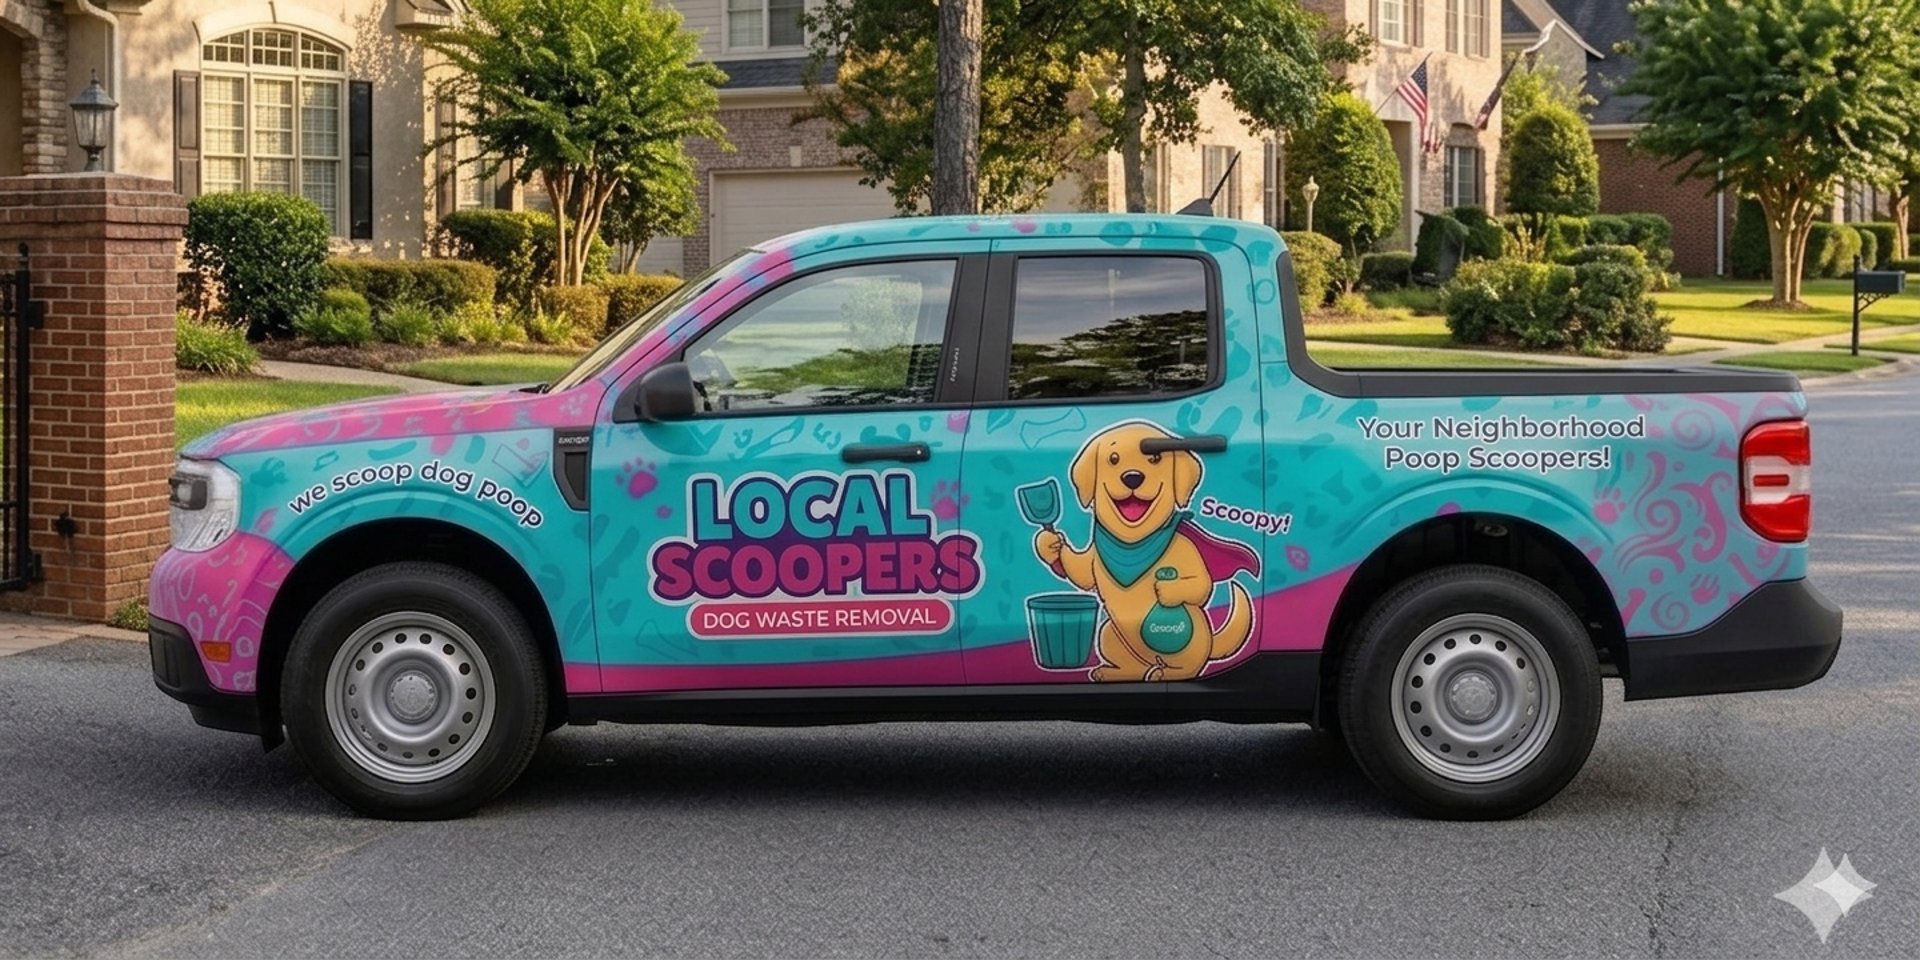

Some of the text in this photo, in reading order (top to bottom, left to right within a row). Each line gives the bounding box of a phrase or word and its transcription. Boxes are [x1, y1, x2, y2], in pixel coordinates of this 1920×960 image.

[1358, 415, 1645, 442] Your Neighborhood
[1385, 446, 1610, 473] Poop Scoopers!
[289, 461, 543, 528] we scoop dog poop
[692, 473, 933, 542] LOCAL
[1202, 499, 1291, 534] Scoopy!
[652, 535, 980, 599] SCOOPERS
[704, 608, 937, 629] DOG WASTE REMOVAL
